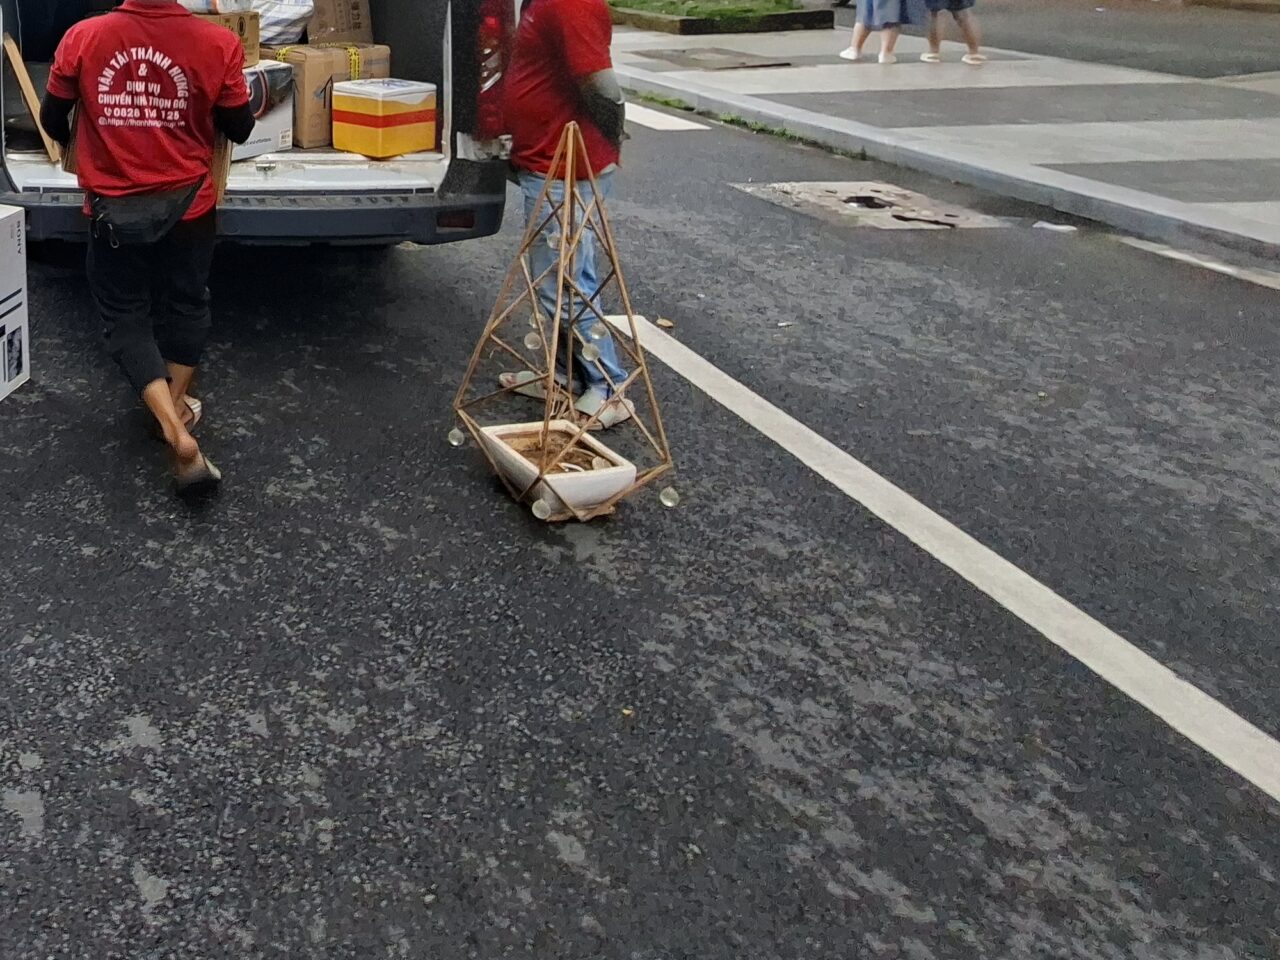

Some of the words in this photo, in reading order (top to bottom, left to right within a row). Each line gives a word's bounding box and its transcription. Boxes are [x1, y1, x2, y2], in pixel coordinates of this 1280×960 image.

[98, 67, 115, 92] VẬN
[110, 51, 130, 70] TẢI
[130, 46, 172, 70] THÀNH
[168, 66, 189, 98] HƯNG
[138, 63, 147, 77] &
[148, 82, 160, 96] VỤ
[149, 95, 171, 109] TRỌN
